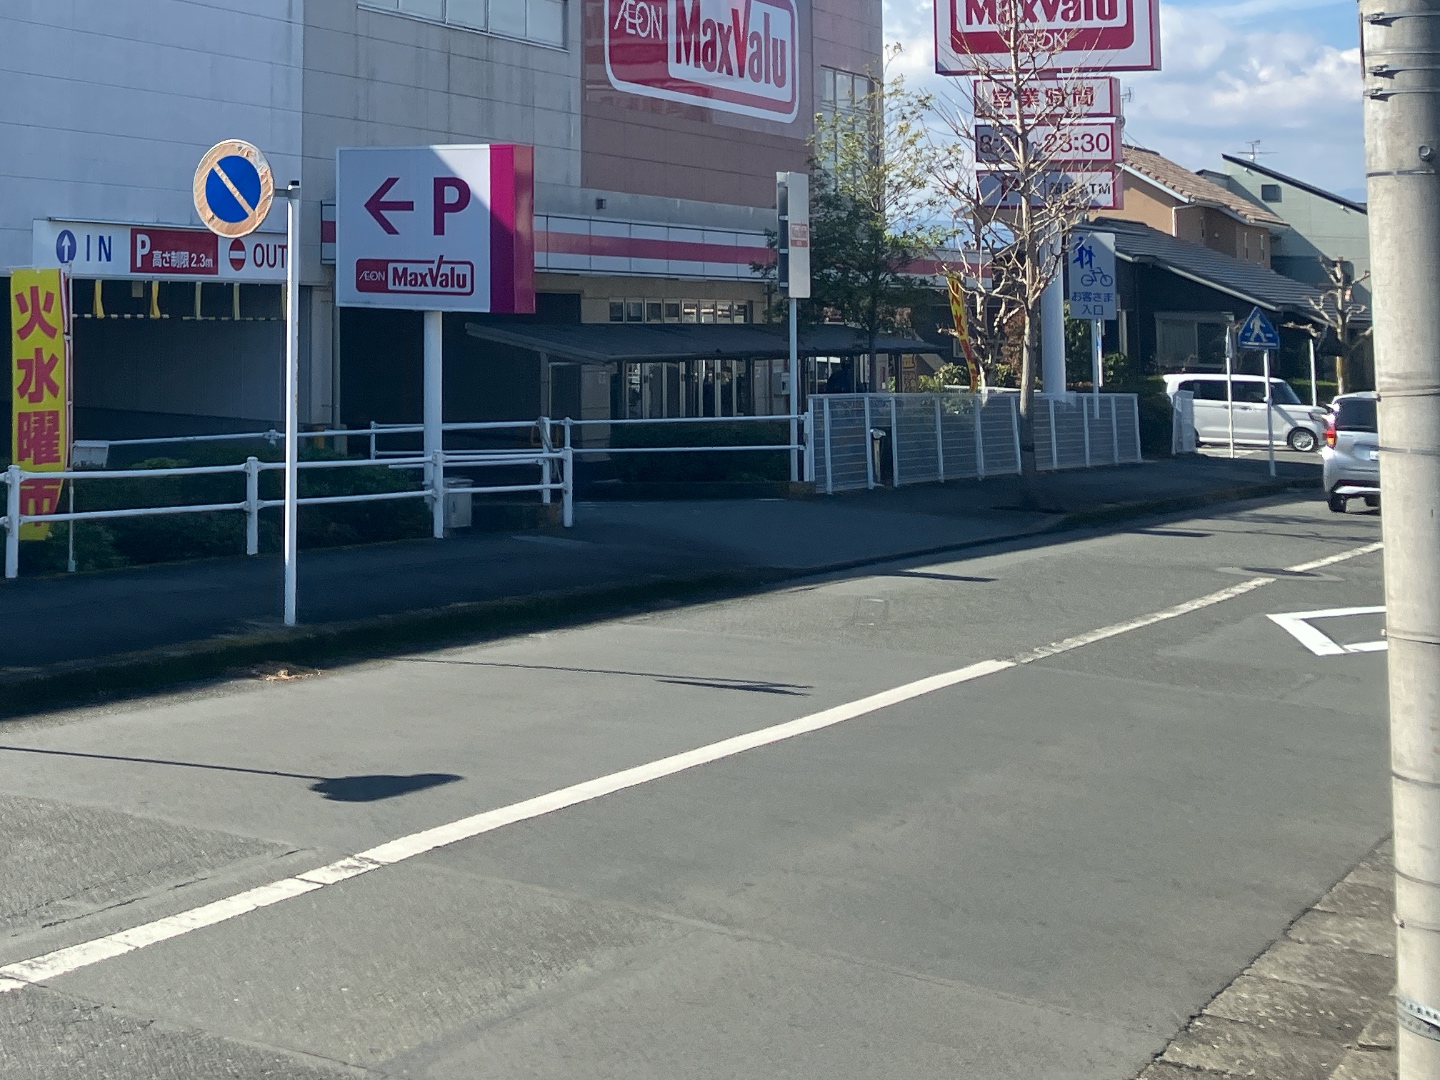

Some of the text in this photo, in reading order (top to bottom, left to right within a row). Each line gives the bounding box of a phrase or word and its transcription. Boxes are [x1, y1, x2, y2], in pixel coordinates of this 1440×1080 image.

[992, 86, 1095, 108] 営業時間
[433, 176, 471, 236] P
[86, 234, 113, 262] IN
[136, 233, 151, 268] P
[253, 242, 288, 269] OUT
[392, 255, 467, 289] MaxValu
[1071, 291, 1114, 302] お客さま
[1081, 304, 1104, 316] 入口
